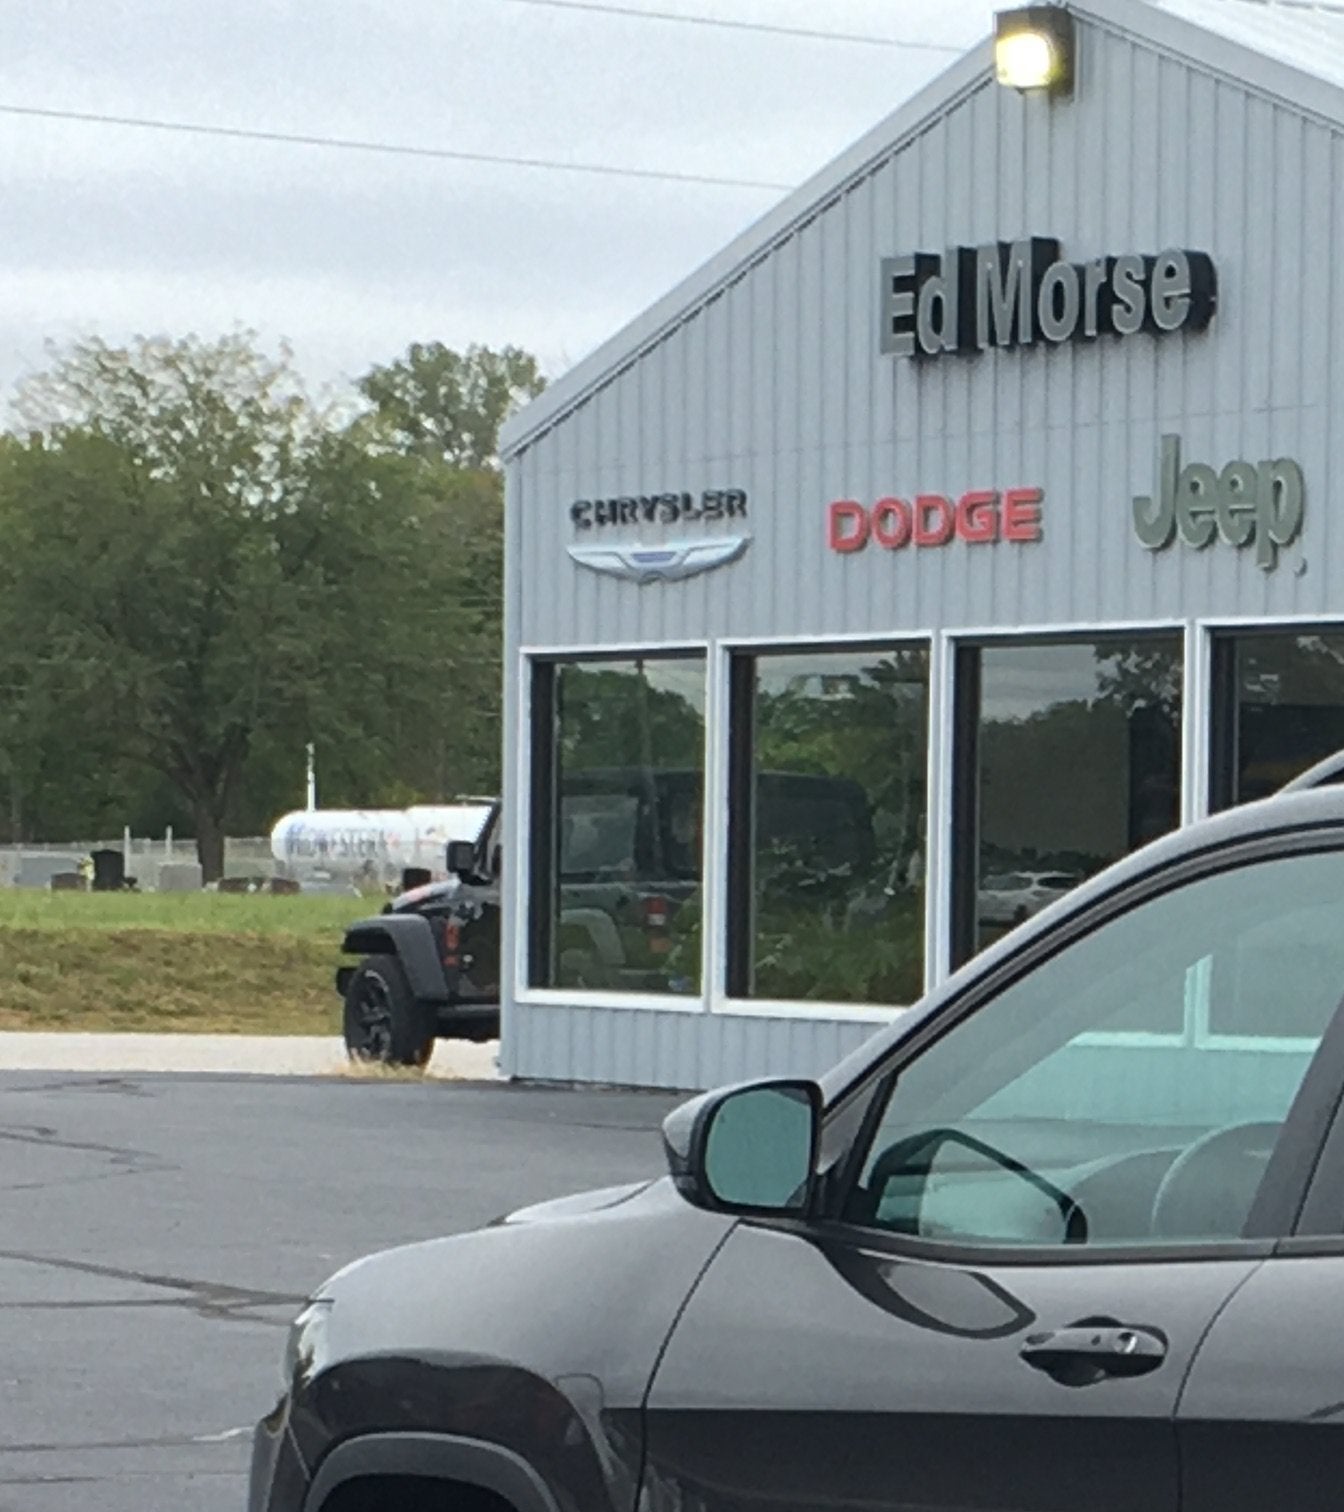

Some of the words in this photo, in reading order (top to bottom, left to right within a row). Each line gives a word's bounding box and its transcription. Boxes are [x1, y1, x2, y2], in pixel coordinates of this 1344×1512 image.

[881, 246, 960, 357] Ed
[977, 236, 1210, 347] Morse
[569, 487, 749, 530] CHRYSLER
[828, 486, 1044, 553] DODGE
[1132, 433, 1306, 571] Jeep
